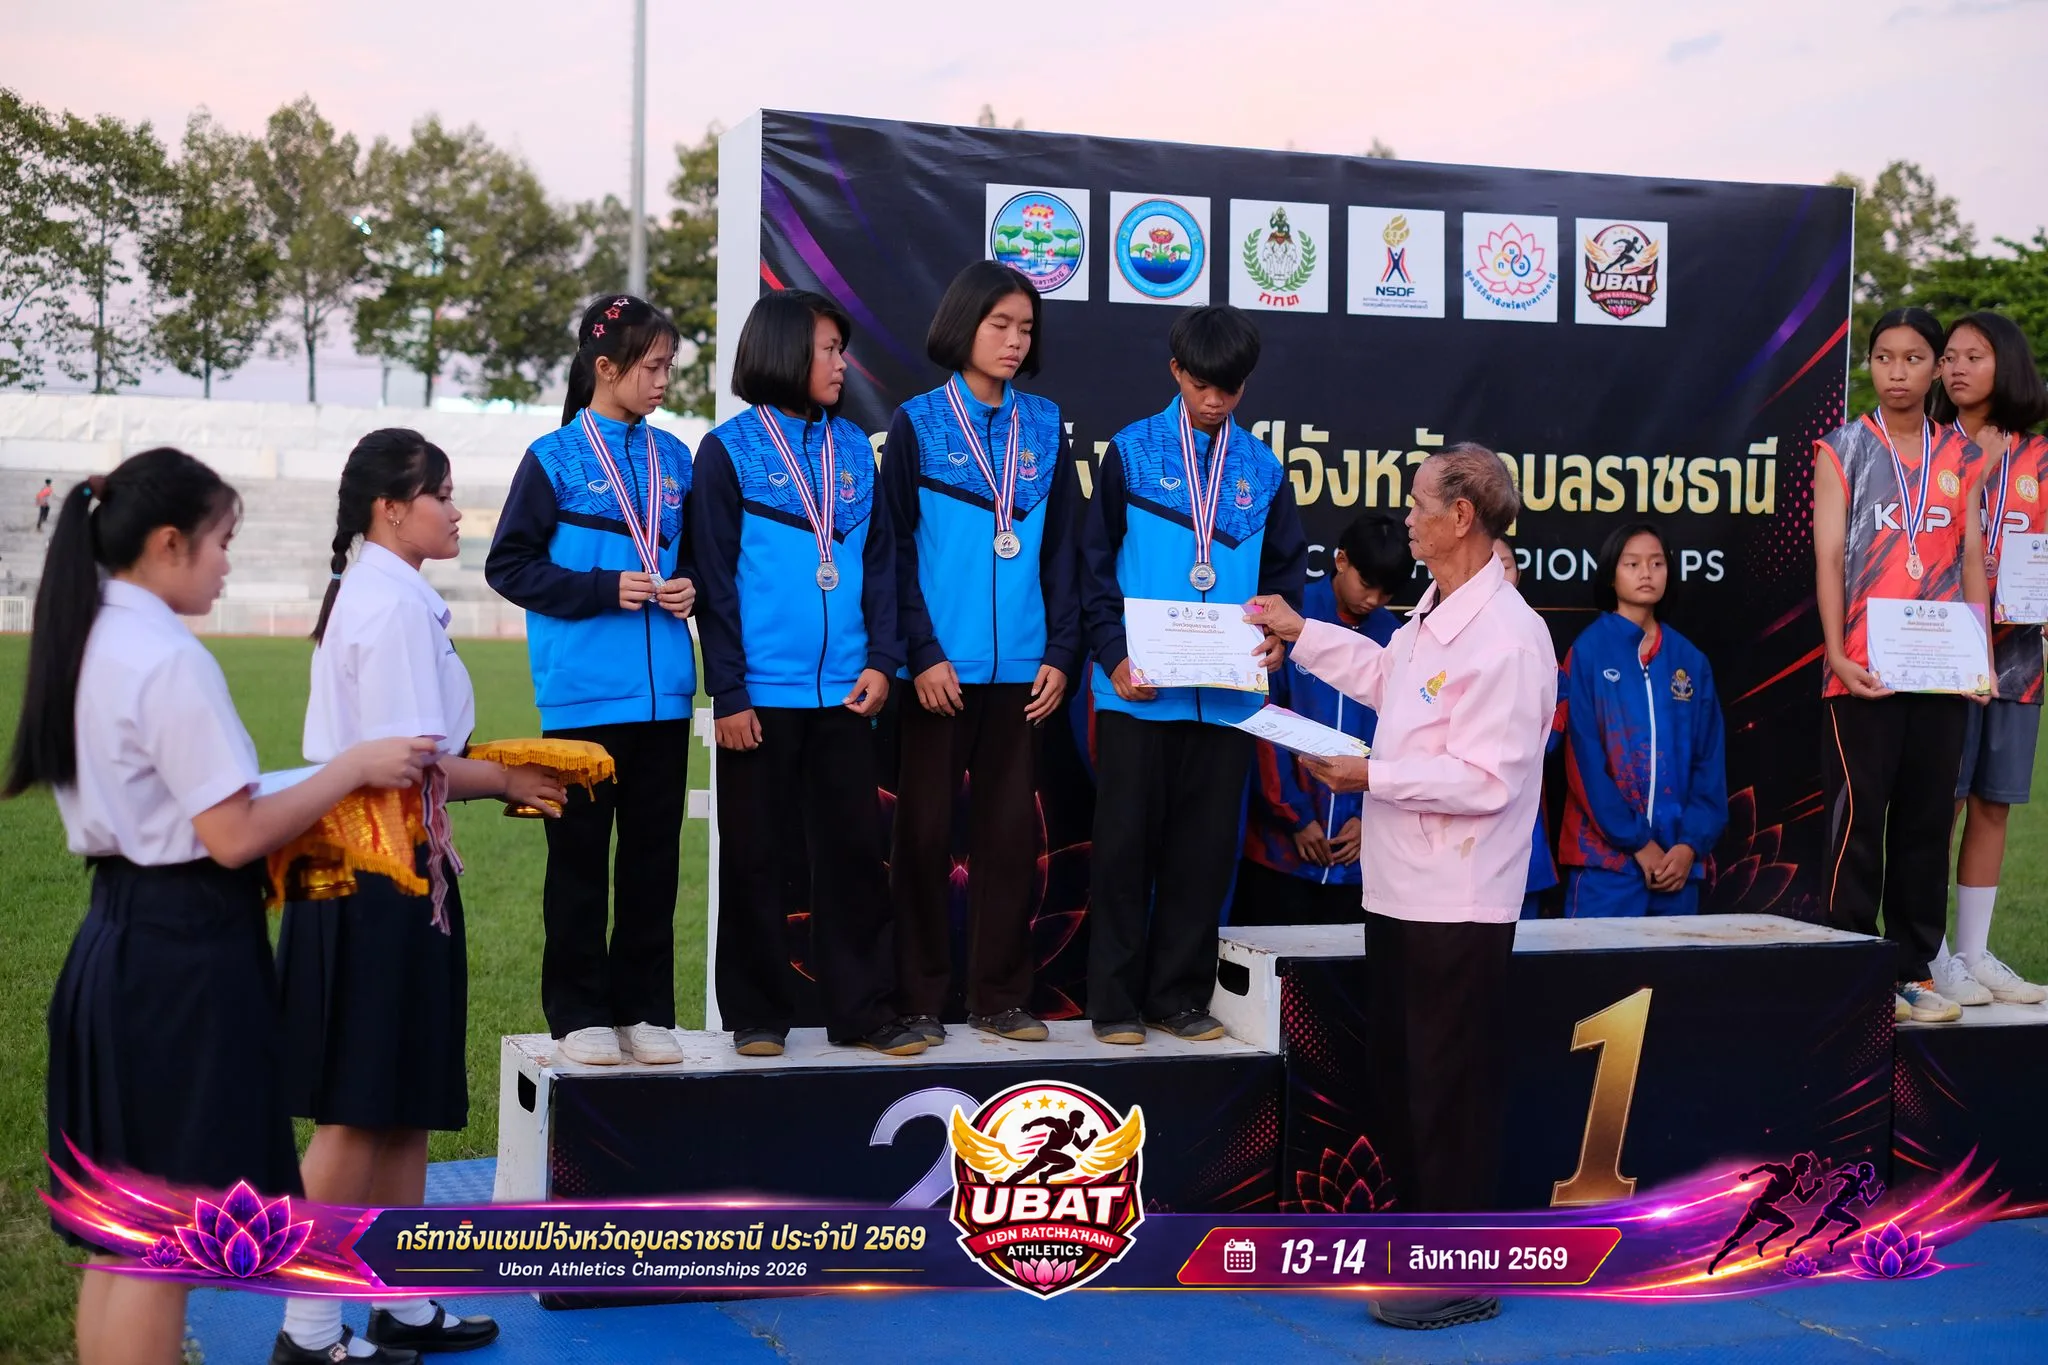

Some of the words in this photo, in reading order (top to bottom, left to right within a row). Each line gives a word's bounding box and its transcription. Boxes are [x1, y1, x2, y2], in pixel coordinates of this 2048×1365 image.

[1375, 286, 1416, 297] NSDF
[1590, 272, 1653, 293] UBAT
[1550, 987, 1653, 1207] 1
[869, 1086, 982, 1208] 2
